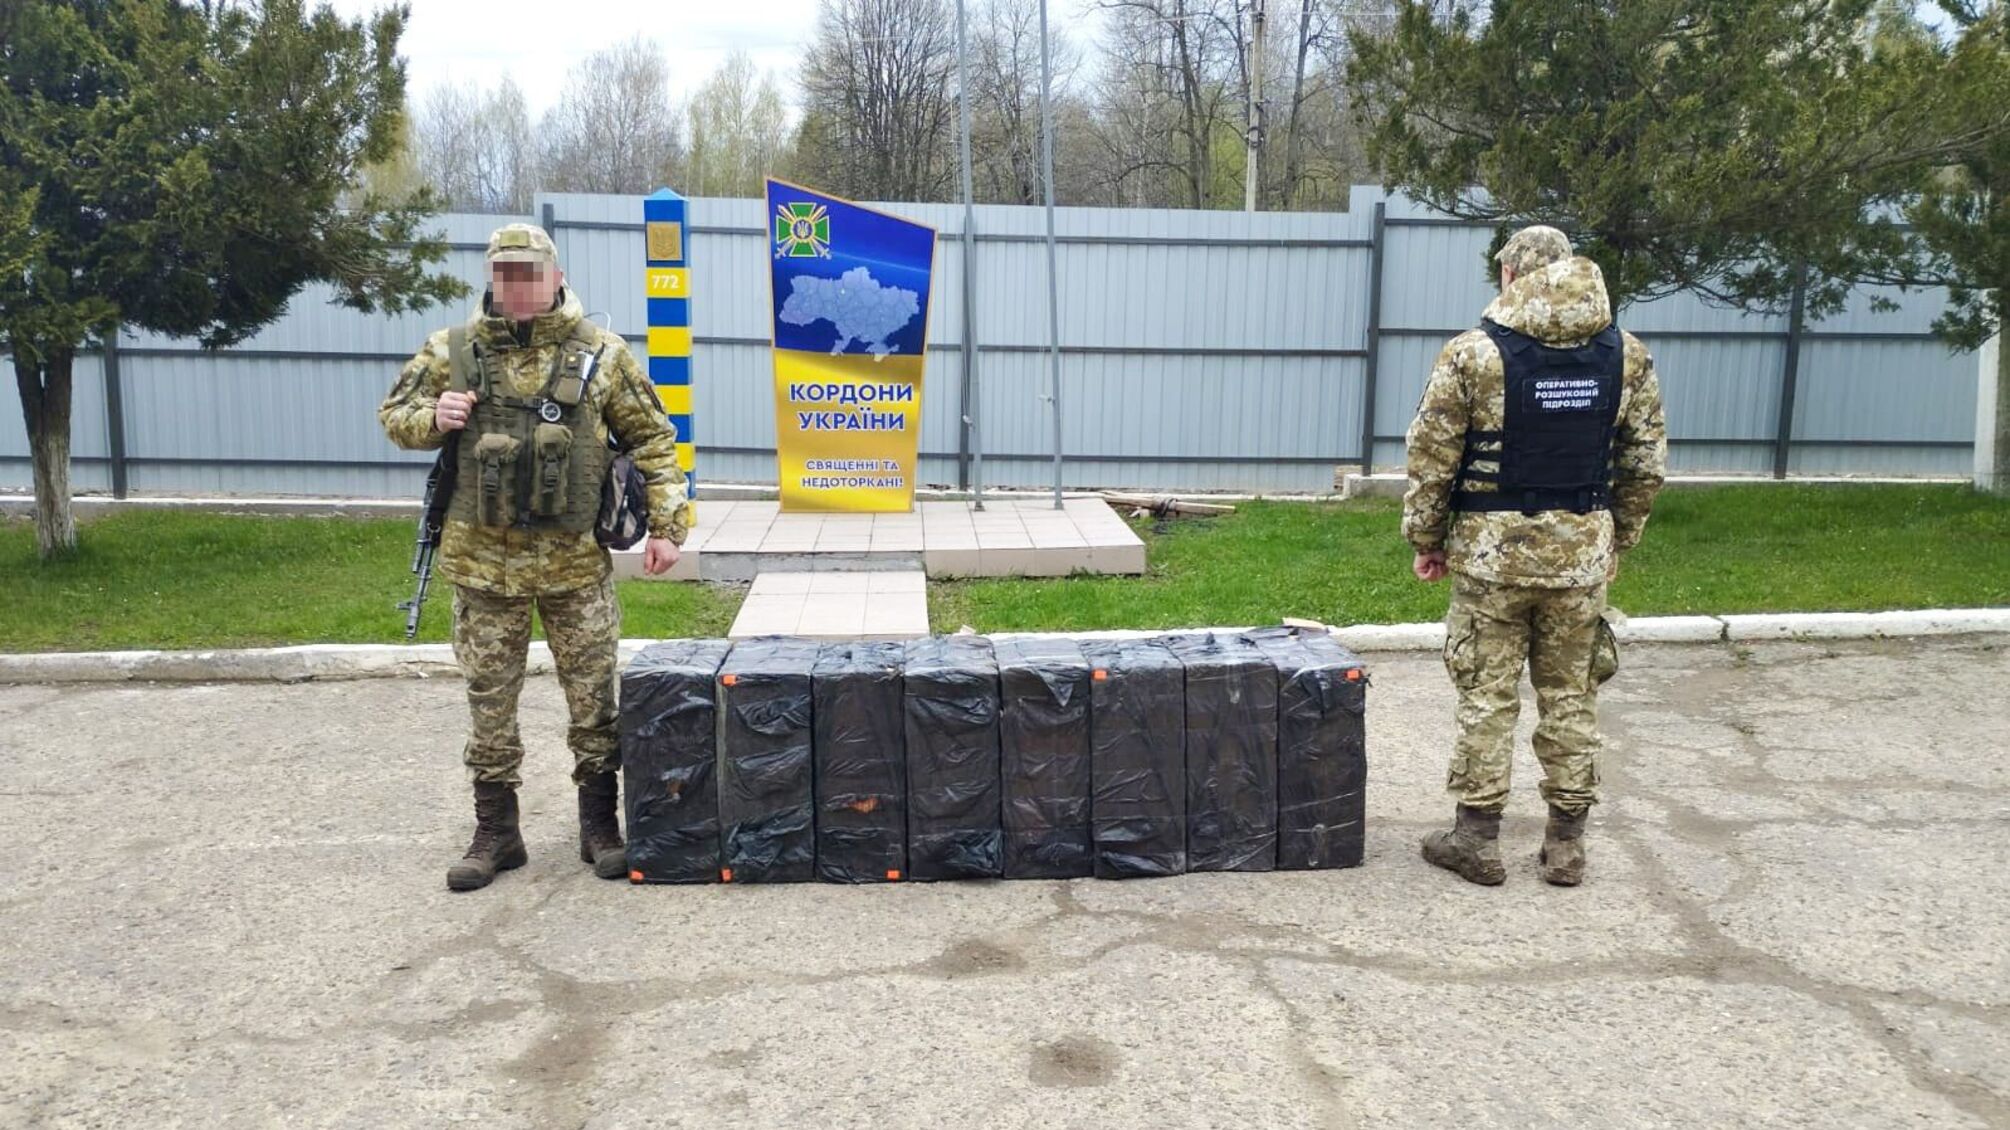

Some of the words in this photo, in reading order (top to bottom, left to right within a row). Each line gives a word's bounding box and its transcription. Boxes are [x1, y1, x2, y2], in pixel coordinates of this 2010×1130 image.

[652, 275, 680, 289] 772
[1535, 380, 1598, 389] ОПЕРАТИВНО-
[790, 384, 913, 404] КОРДОНИ
[1535, 388, 1599, 399] РОЗШУКОВИЙ
[1542, 399, 1591, 408] ПІДРОЗДІЛ
[798, 407, 904, 430] УКРАЇНИ
[806, 461, 878, 471] СВЯЩЕННІ
[883, 461, 899, 470] ТА
[802, 477, 903, 488] НЕДОТОРКАНІ!
